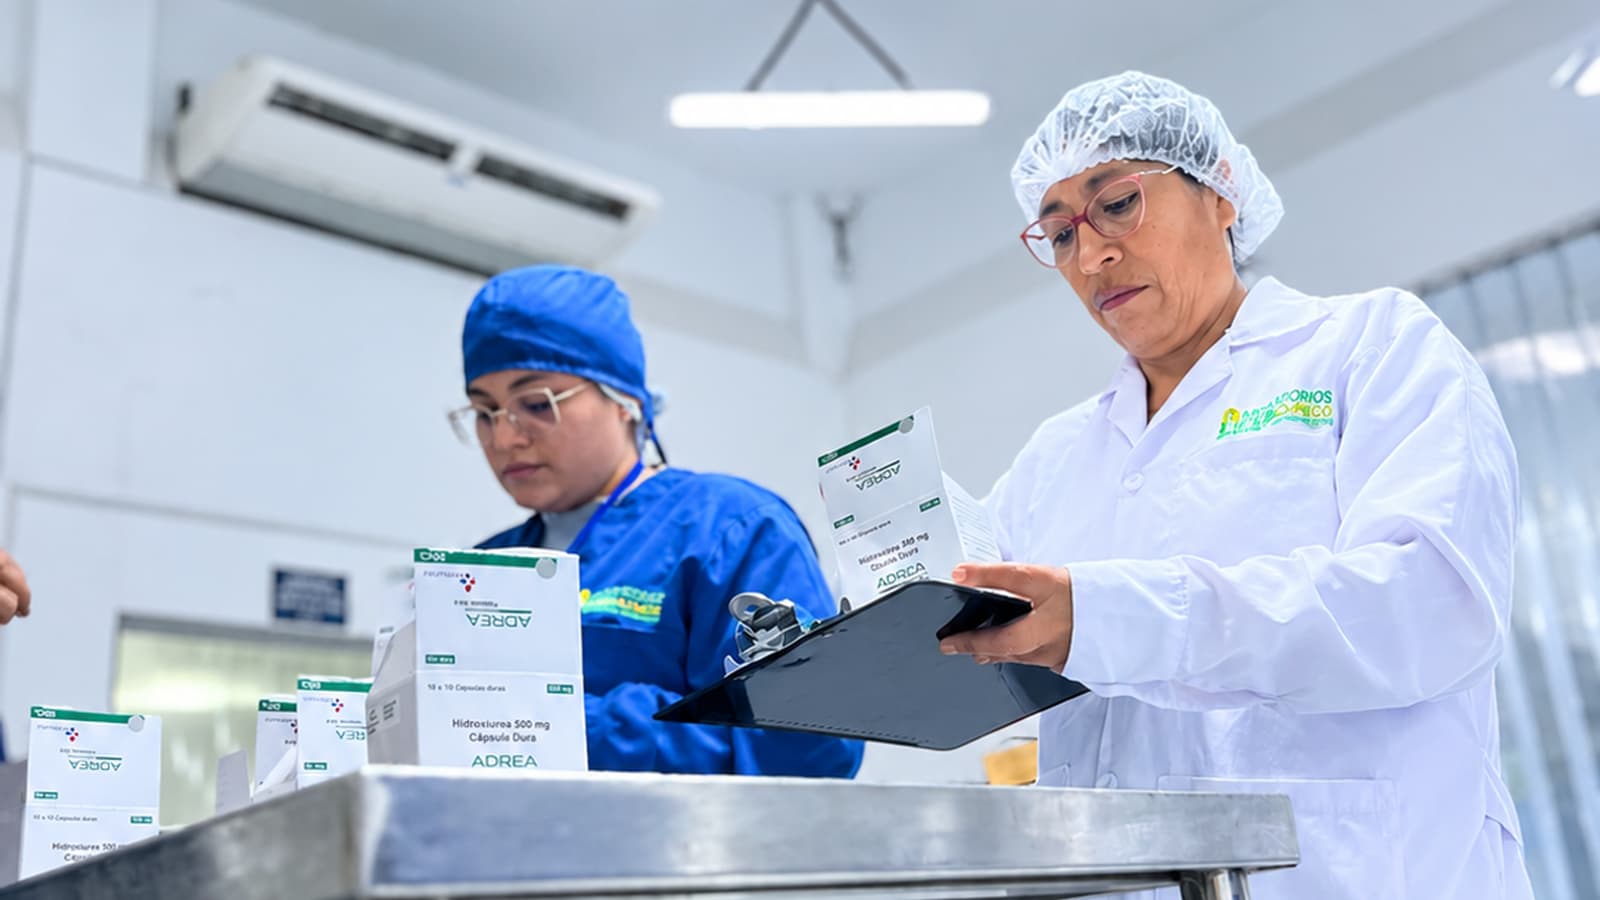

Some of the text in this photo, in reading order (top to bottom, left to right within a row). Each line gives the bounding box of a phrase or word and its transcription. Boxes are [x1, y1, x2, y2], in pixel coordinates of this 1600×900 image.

[466, 614, 532, 628] ADREA
[514, 719, 533, 729] 500
[535, 721, 550, 731] mg
[512, 732, 537, 742] Dura
[68, 759, 122, 772] ADREA
[471, 754, 538, 768] ADREA
